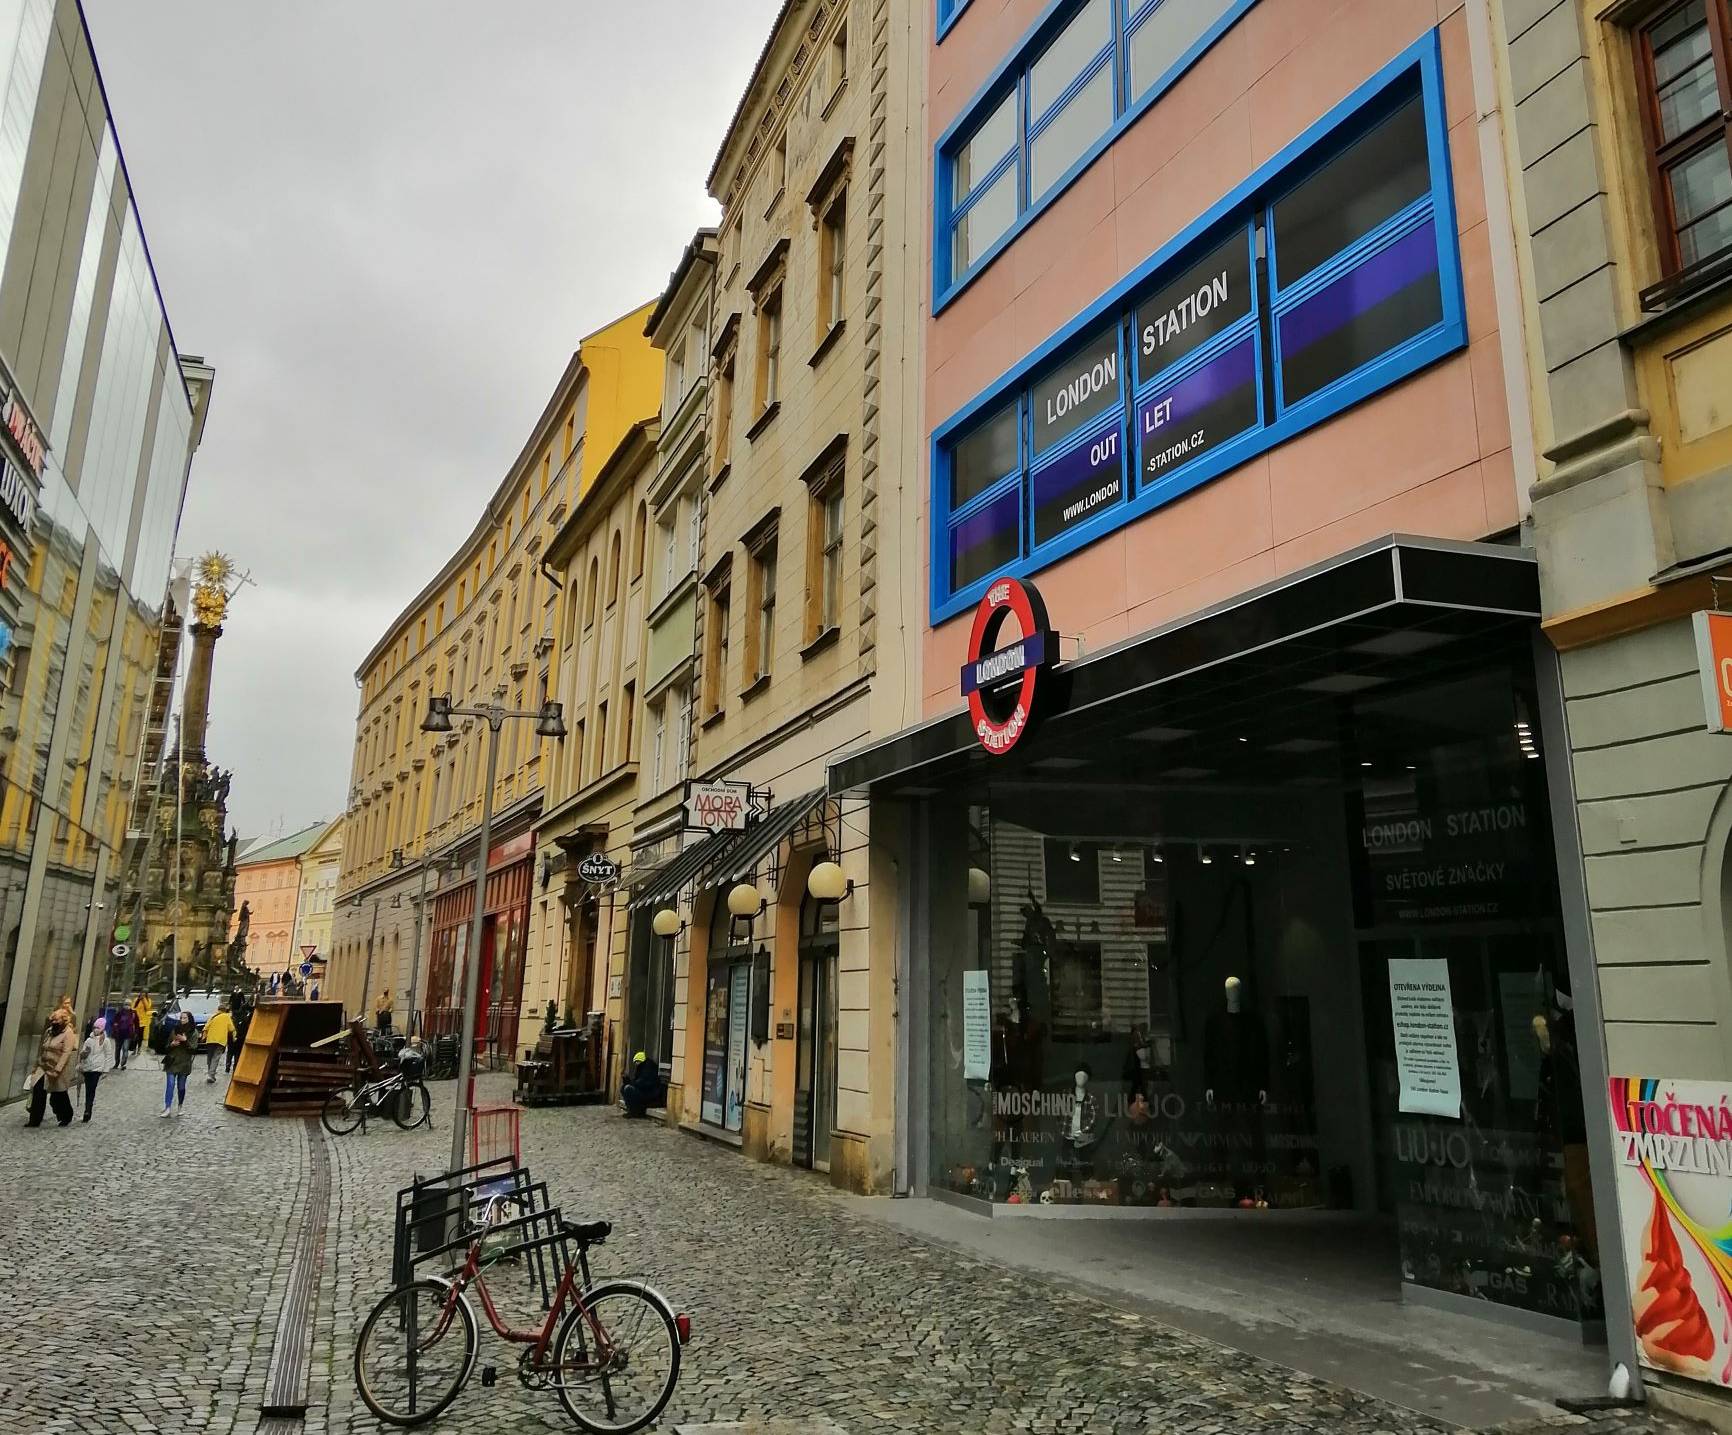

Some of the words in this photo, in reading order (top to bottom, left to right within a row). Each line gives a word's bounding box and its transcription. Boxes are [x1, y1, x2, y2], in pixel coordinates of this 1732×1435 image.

[1047, 352, 1116, 425] LONDON
[1142, 269, 1227, 355] STATION
[1090, 432, 1118, 466] OUT
[1145, 396, 1173, 433] LET
[1063, 479, 1119, 521] WWW.LONDON
[987, 583, 1011, 607] THE
[975, 643, 1025, 684] LONDON
[977, 703, 1026, 748] STATION
[694, 793, 743, 812] MORA
[698, 808, 738, 828] TONY
[1362, 817, 1432, 848] LONDON
[1447, 803, 1527, 837] STATION
[581, 862, 613, 875] ŠNYT
[1385, 865, 1445, 891] SVĚTOVÉ
[1448, 860, 1505, 885] ZNAČKY
[1627, 1092, 1732, 1141] TOČENÁ
[1618, 1131, 1732, 1177] ZMRZLIN
